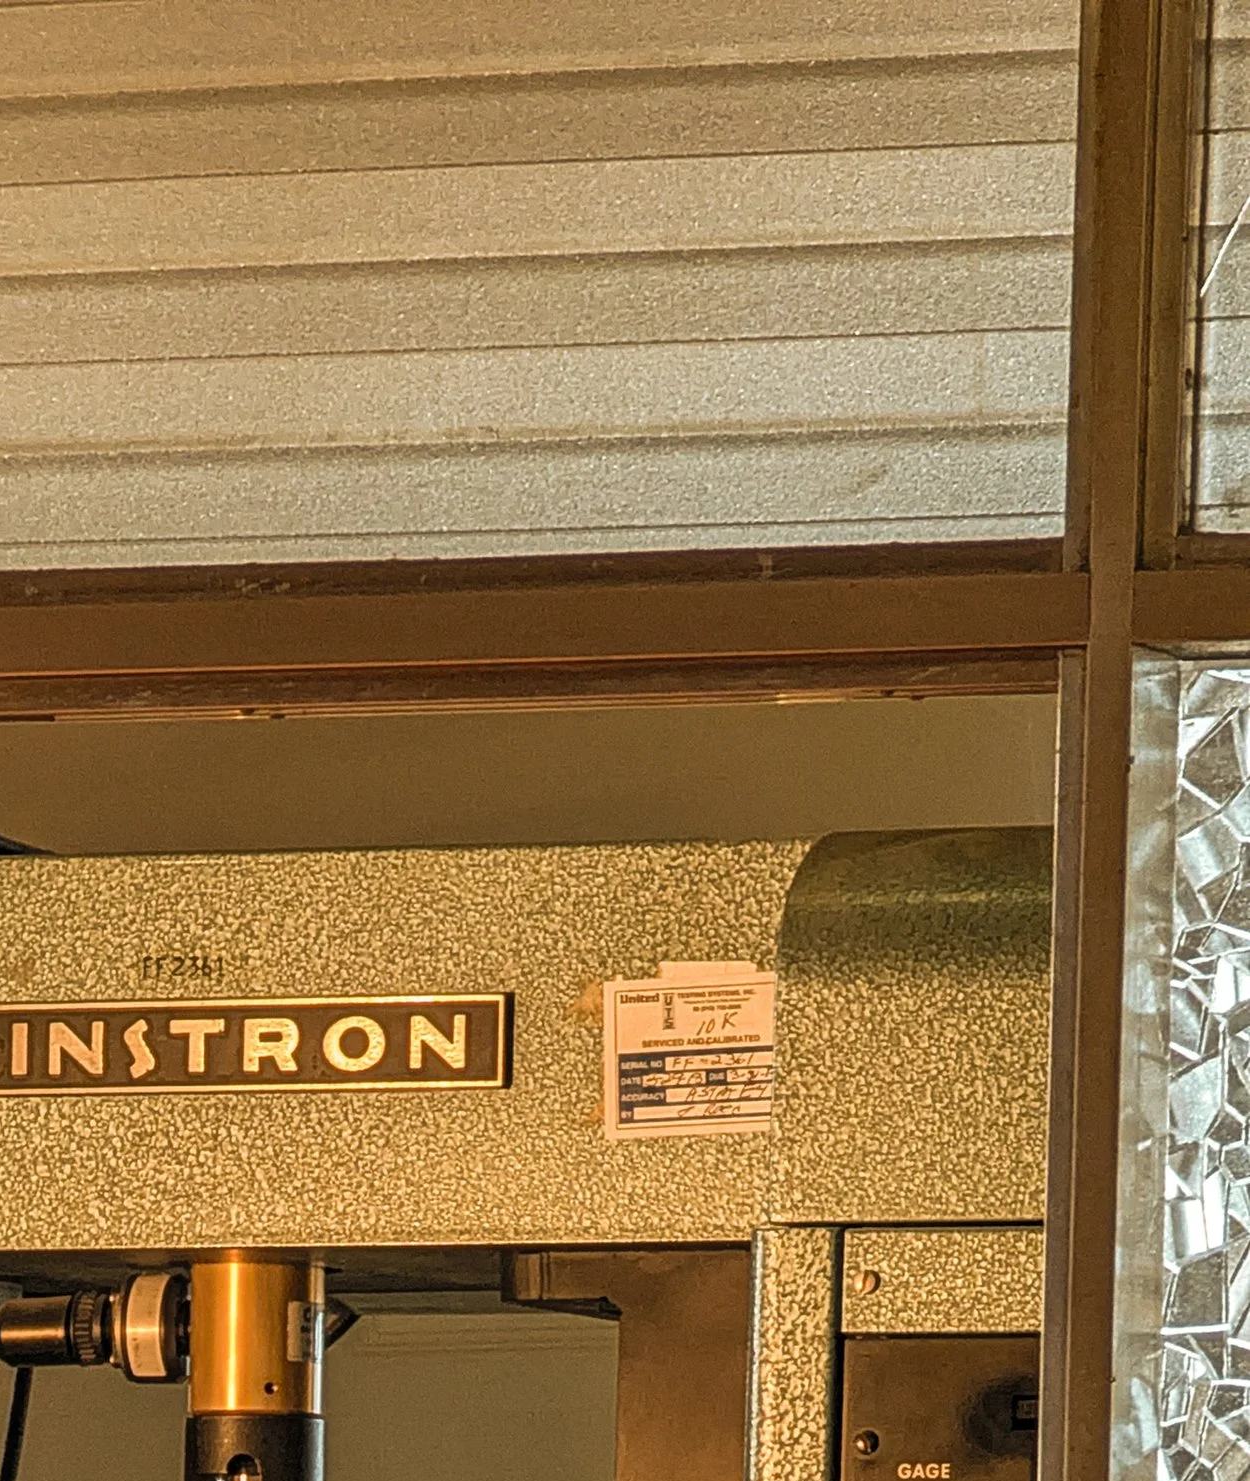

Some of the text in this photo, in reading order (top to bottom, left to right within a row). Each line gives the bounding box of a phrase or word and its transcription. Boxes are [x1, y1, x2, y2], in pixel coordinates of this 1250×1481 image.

[620, 993, 660, 1004] United
[8, 1013, 468, 1079] INSTRON
[642, 1038, 684, 1048] SERVICED
[897, 1463, 951, 1480] GAGE
